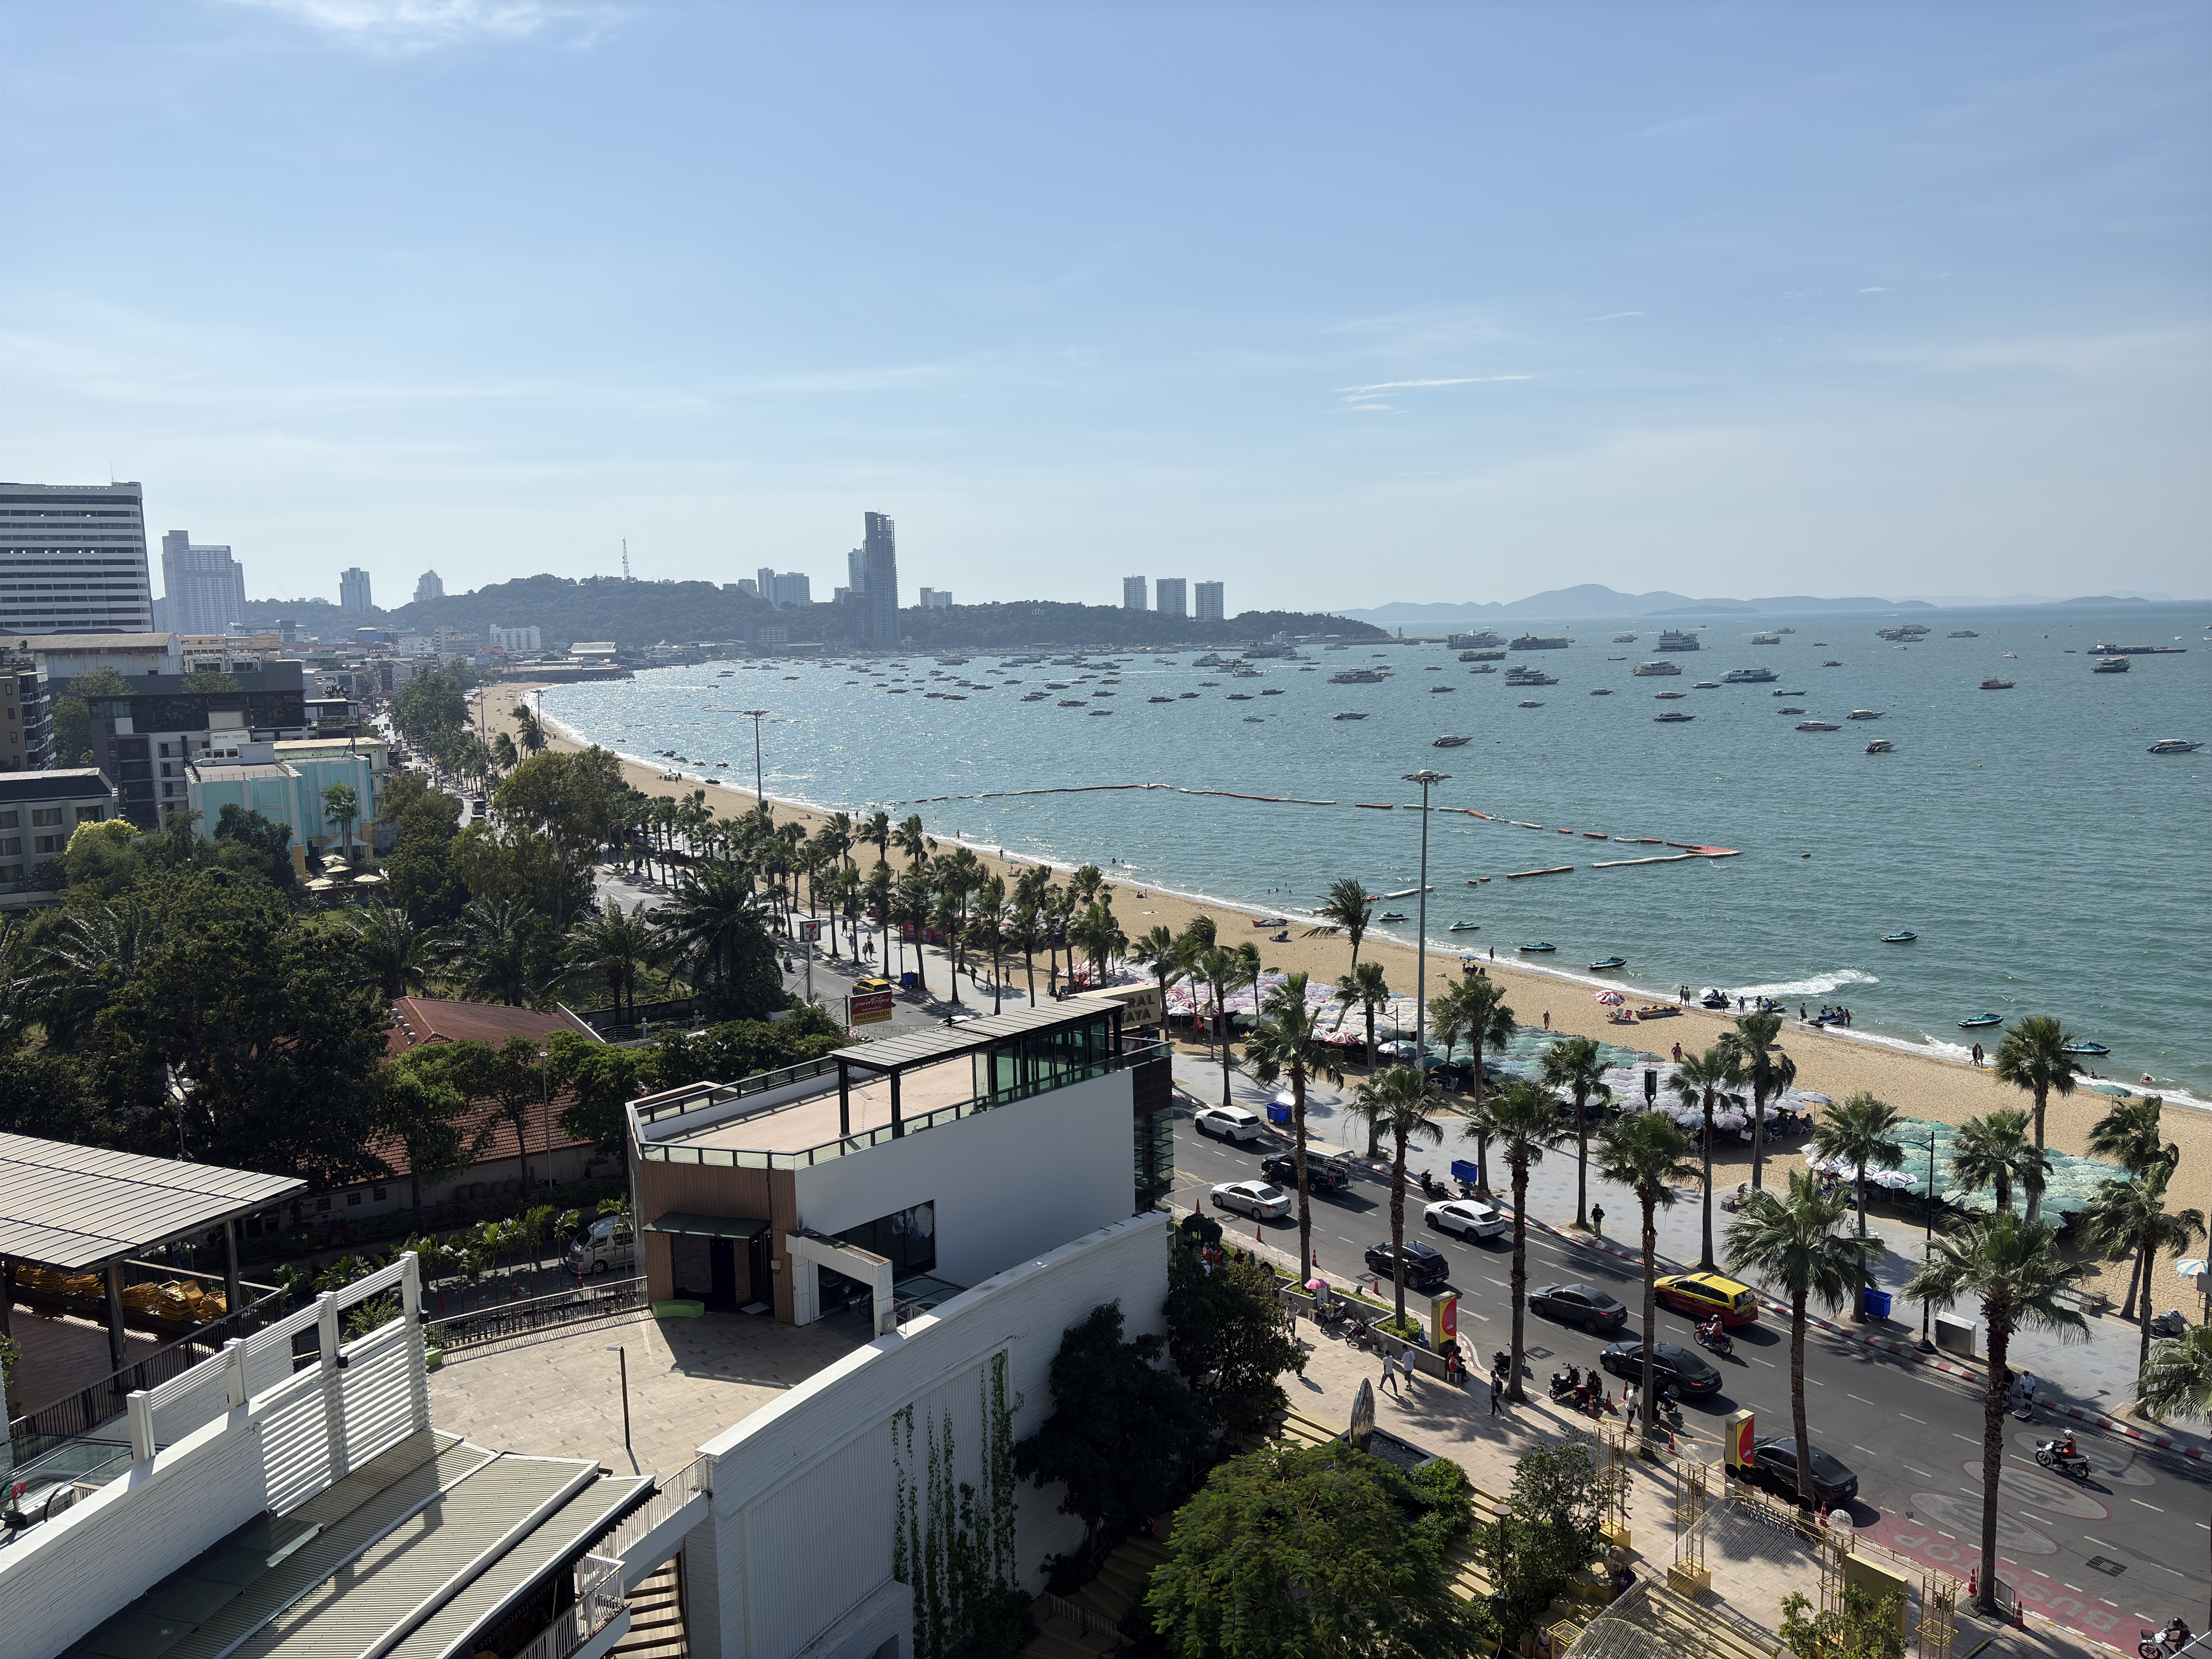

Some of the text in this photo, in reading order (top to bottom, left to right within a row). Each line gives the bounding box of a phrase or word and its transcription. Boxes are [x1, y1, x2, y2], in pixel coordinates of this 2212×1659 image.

[806, 924, 817, 940] 7
[854, 1010, 890, 1021] MAESRIRUEN
[2018, 1582, 2120, 1632] BUS
